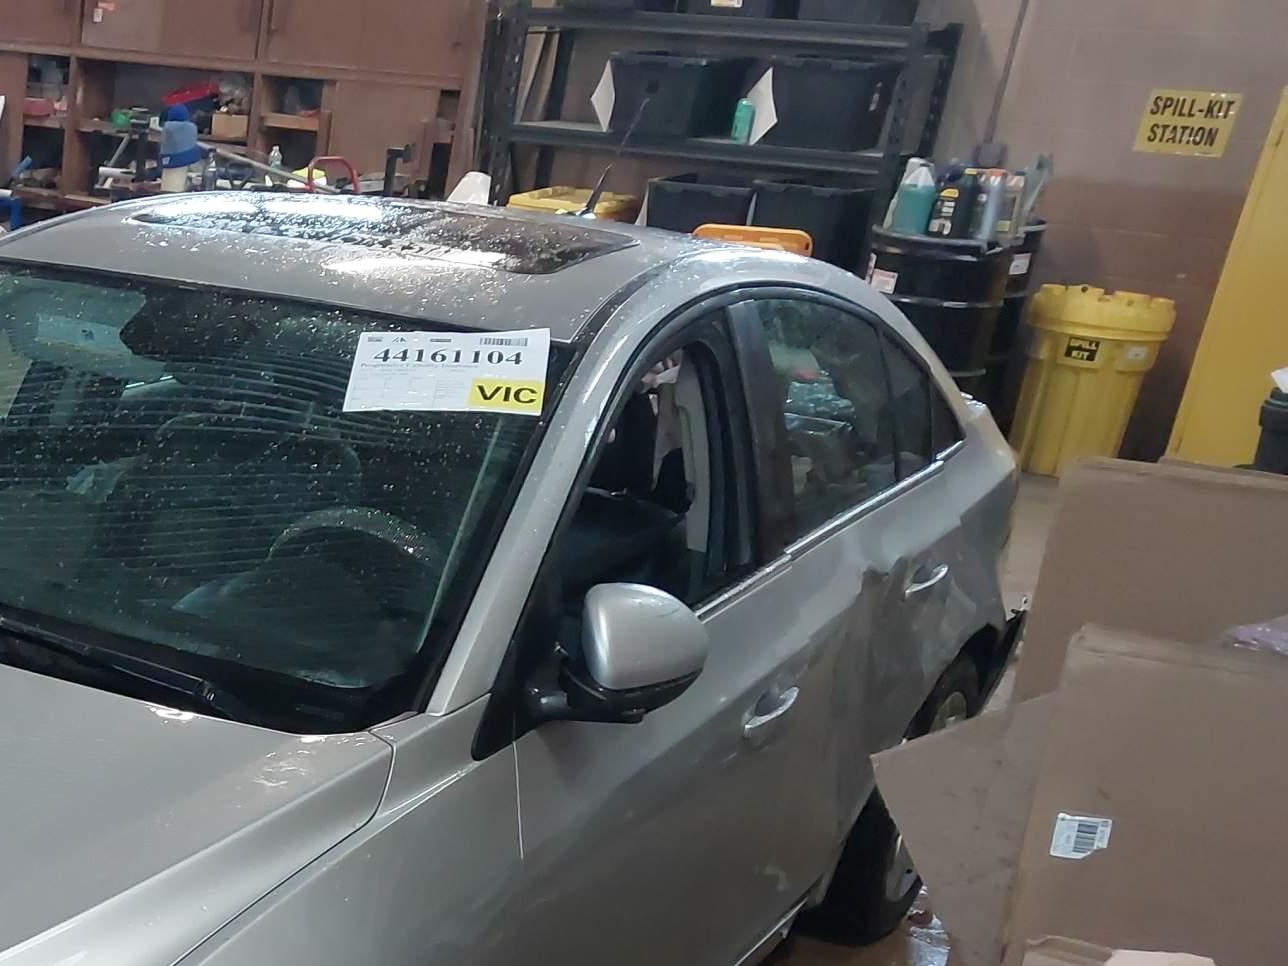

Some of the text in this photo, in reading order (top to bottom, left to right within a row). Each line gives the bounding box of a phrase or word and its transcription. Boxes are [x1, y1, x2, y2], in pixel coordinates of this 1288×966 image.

[1150, 96, 1235, 119] SPILL-KIT
[1147, 123, 1219, 147] STATION
[374, 348, 523, 365] 44161104
[477, 385, 537, 404] VIC
